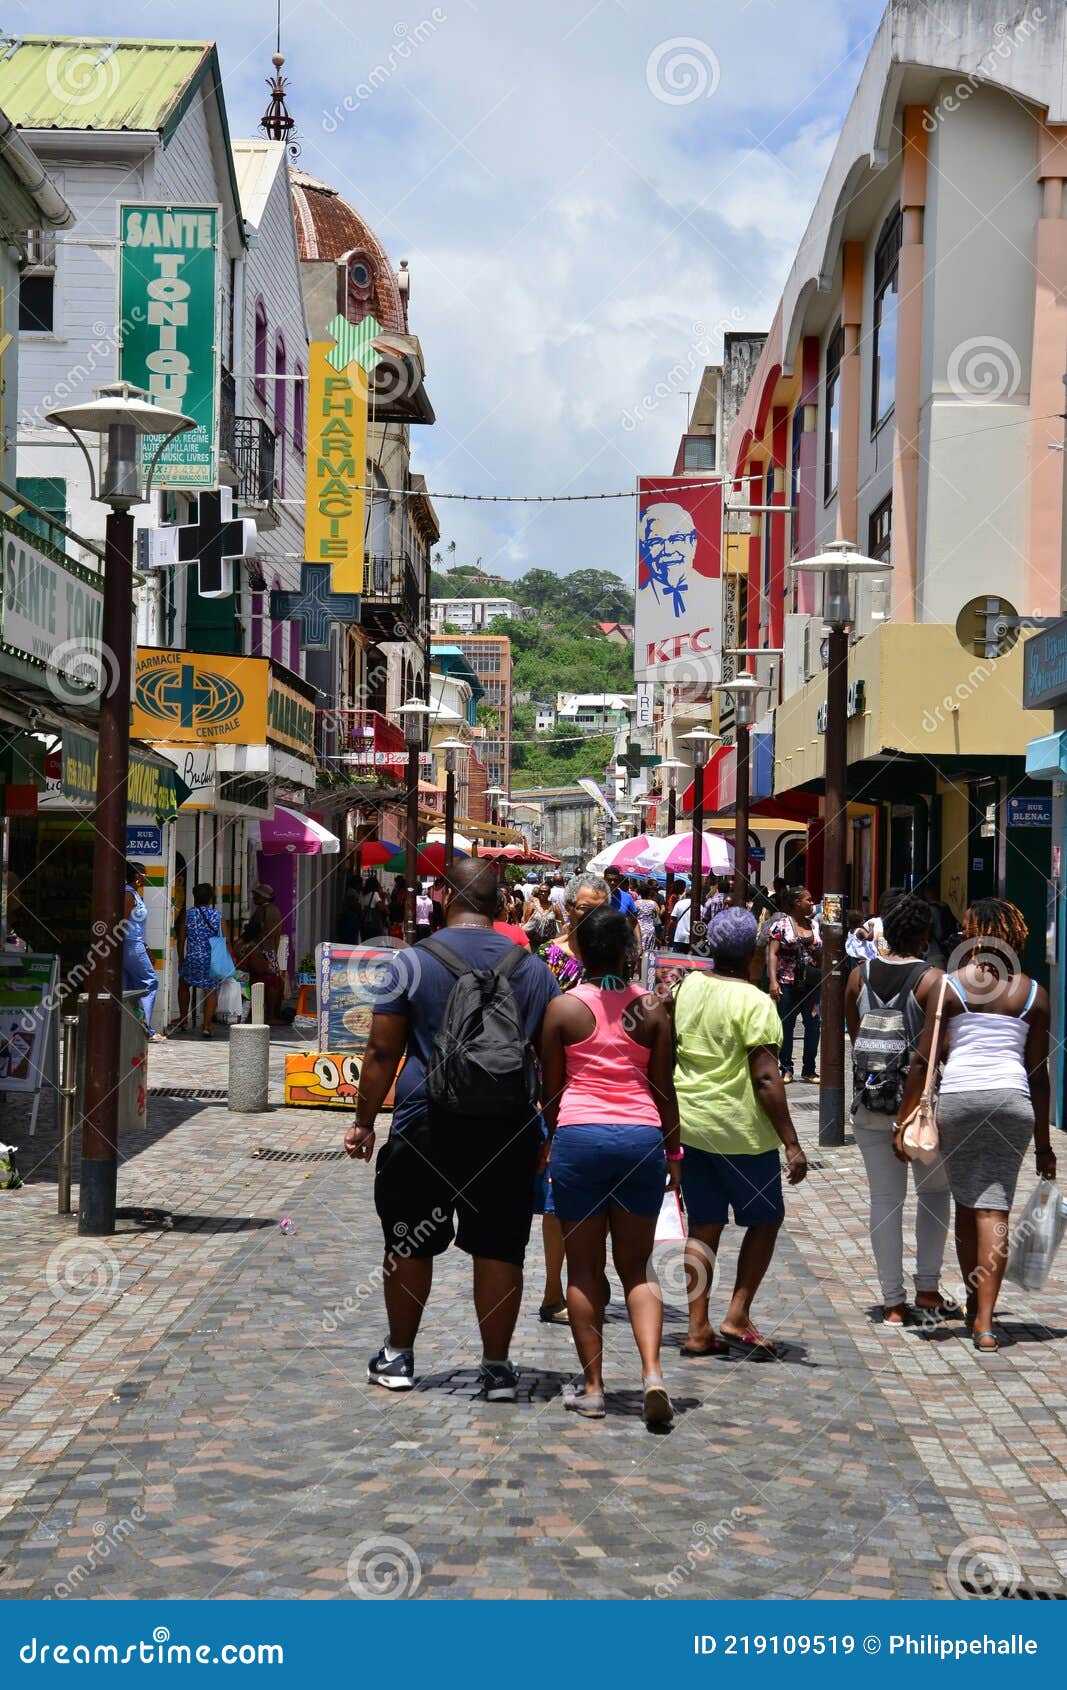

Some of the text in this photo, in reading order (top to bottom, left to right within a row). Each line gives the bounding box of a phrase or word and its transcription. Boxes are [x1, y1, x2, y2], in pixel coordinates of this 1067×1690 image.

[126, 212, 212, 248] SANTE
[317, 376, 356, 558] PHARMACIE
[6, 541, 57, 636] SANTE
[646, 627, 712, 667] KFC
[136, 653, 182, 674] HARMACIE
[196, 718, 241, 738] CENTRALE
[1012, 812, 1050, 821] BLENAC
[127, 840, 158, 849] ENAC
